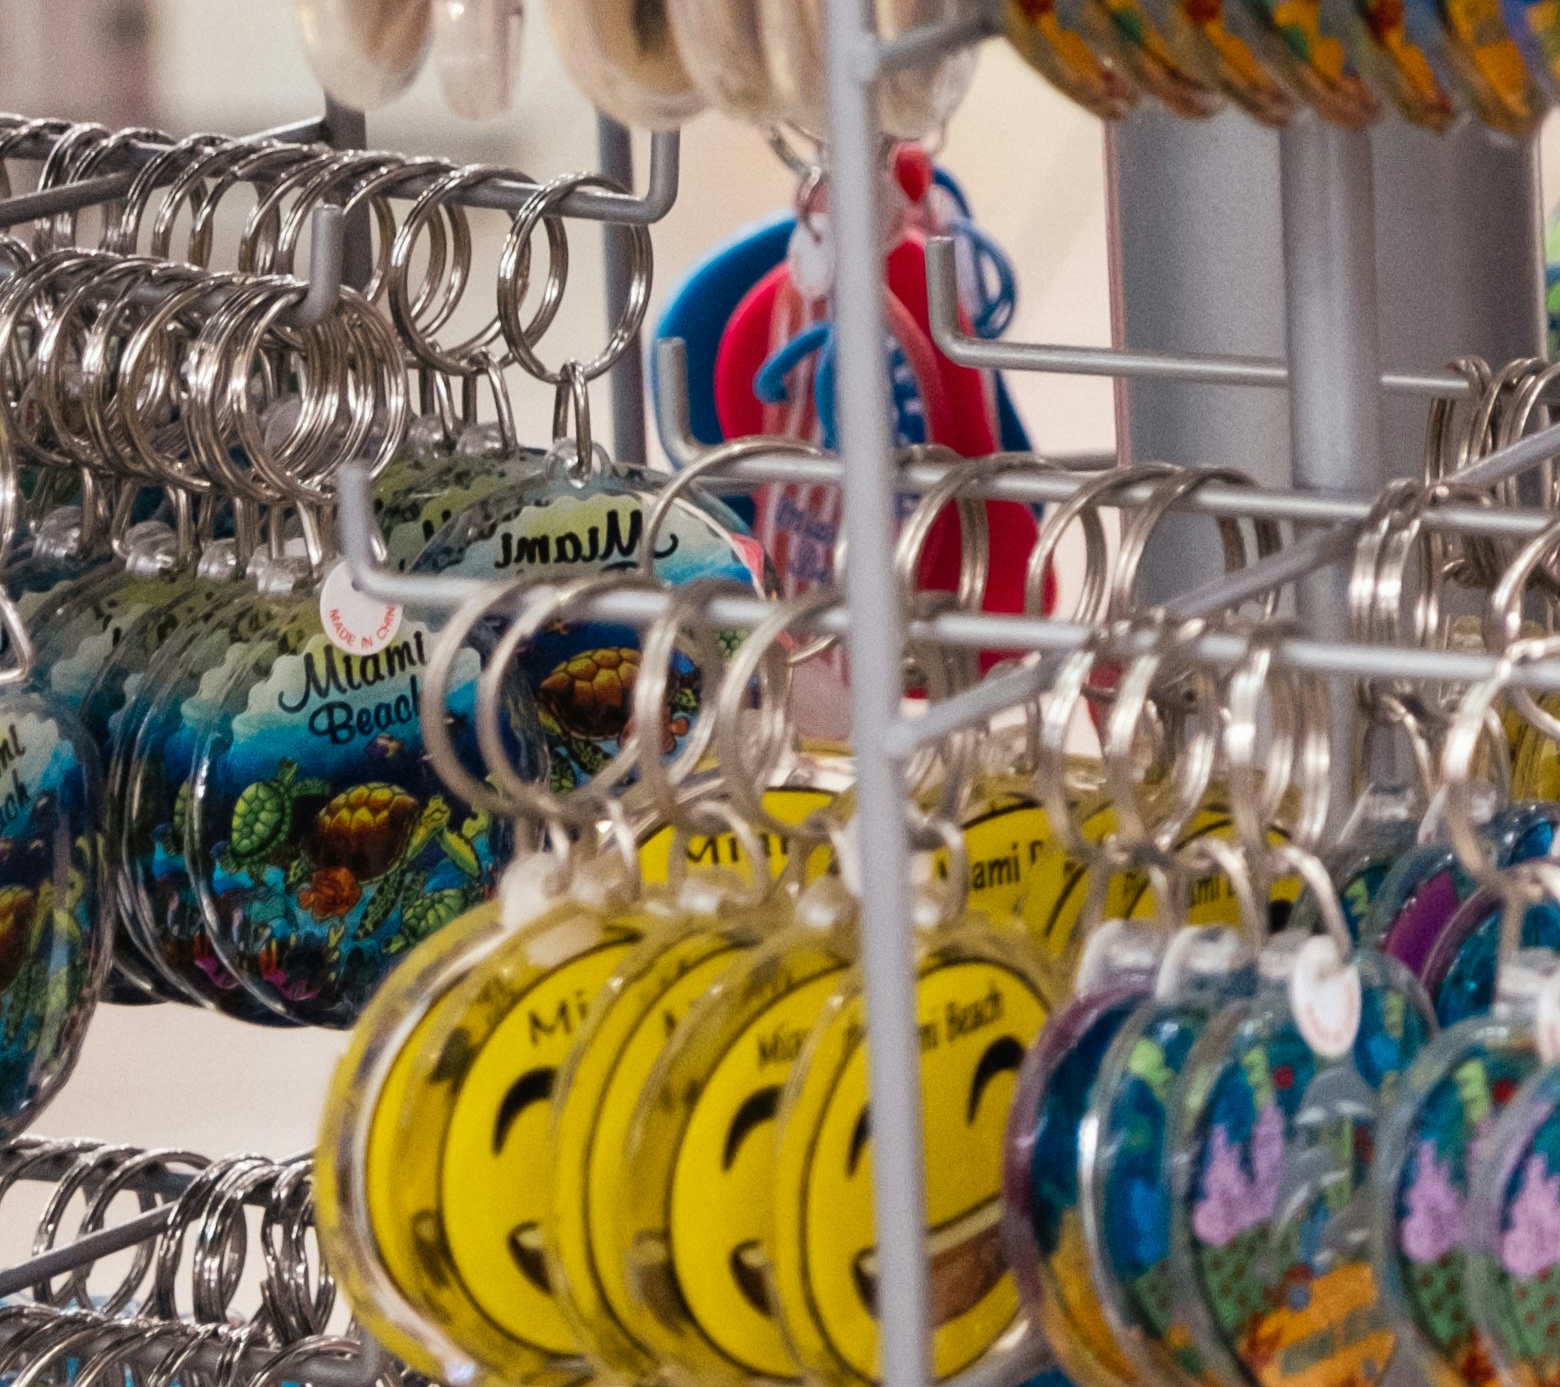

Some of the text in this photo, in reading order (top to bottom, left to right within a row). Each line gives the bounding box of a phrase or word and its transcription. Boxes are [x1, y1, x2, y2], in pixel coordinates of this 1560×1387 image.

[329, 608, 373, 648] MADE IN
[278, 631, 426, 713] Miami
